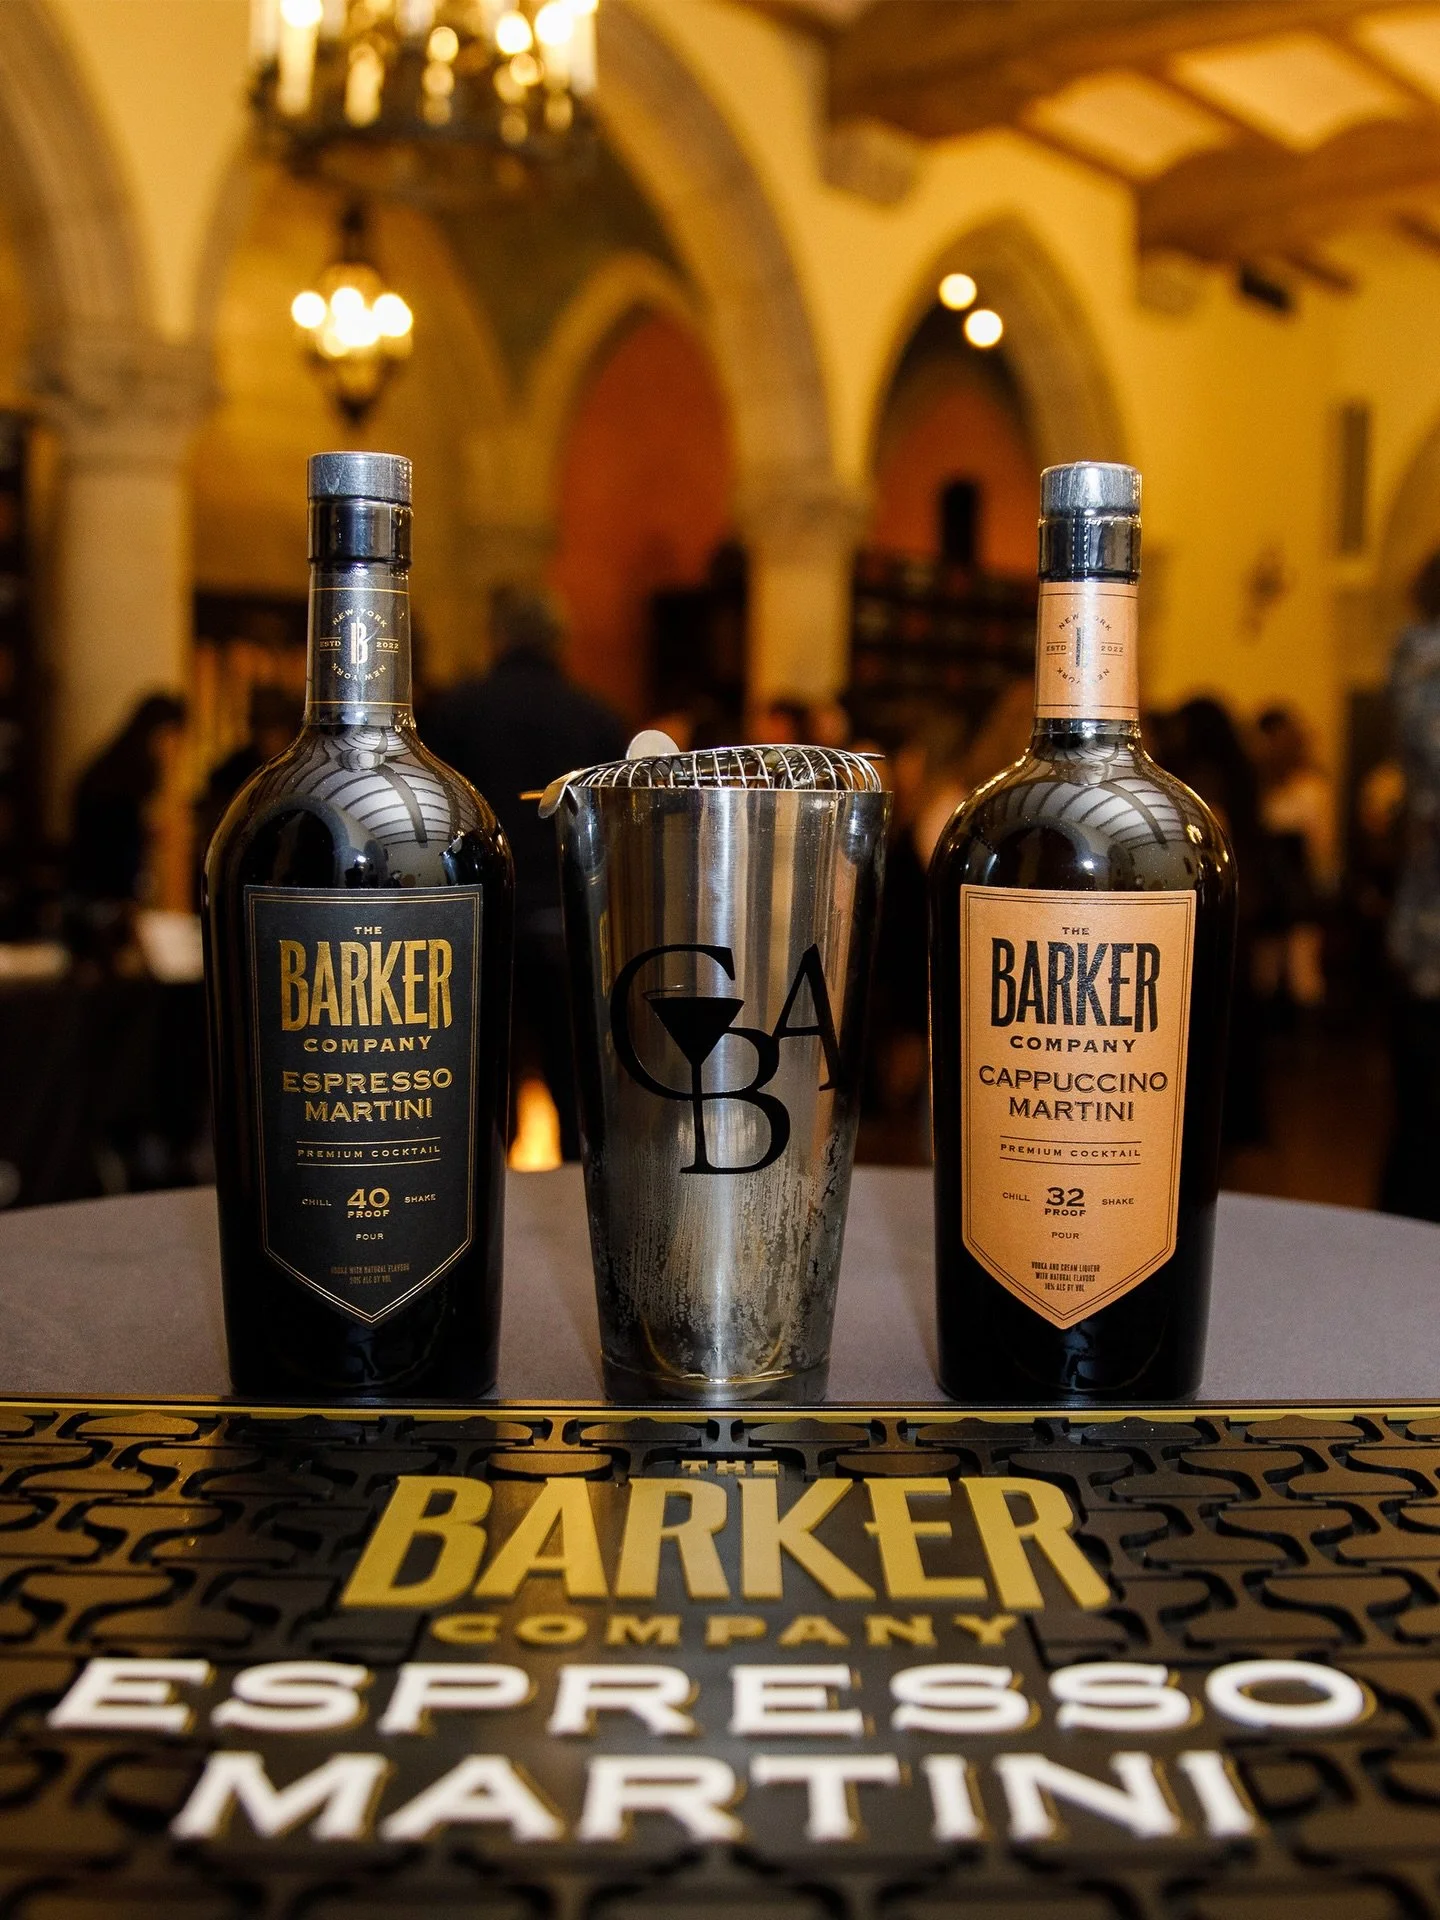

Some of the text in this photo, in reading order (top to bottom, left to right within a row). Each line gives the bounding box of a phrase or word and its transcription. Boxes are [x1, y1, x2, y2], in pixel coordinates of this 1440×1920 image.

[332, 608, 388, 628] NEW YORK
[1058, 612, 1080, 630] NEW
[319, 640, 399, 650] ESTD 2022
[1046, 644, 1124, 653] ESTD 2022
[331, 662, 387, 682] NEW YORK
[354, 926, 383, 935] THE
[1062, 926, 1090, 936] THE
[278, 938, 453, 1032] BARKER
[991, 937, 1161, 1032] BARKER
[303, 1035, 432, 1053] COMPANY
[1009, 1035, 1137, 1053] COMPANY
[282, 1067, 453, 1094] ESPRESSO
[979, 1065, 1169, 1094] CAPPUCCINO
[304, 1097, 433, 1123] MARTINI
[1009, 1096, 1135, 1121] MARTINI
[297, 1145, 441, 1159] PREMIUM COCKTAIL
[1000, 1143, 1141, 1158] PREMIUM COCKTAIL
[301, 1197, 332, 1207] CHILL
[347, 1187, 391, 1209] 40
[404, 1193, 437, 1204] SHAKE
[1002, 1191, 1031, 1202] CHILL
[1046, 1186, 1086, 1208] 32
[1101, 1197, 1135, 1206] SHAKE
[347, 1209, 391, 1218] PROOF
[1044, 1208, 1087, 1217] PROOF
[355, 1232, 384, 1241] POUR
[1051, 1231, 1080, 1240] POUR
[341, 1475, 1112, 1611] BARKER
[431, 1614, 1020, 1648] COMPANY
[48, 1658, 1375, 1736] ESPRESSO
[172, 1750, 1262, 1843] MARTINI
